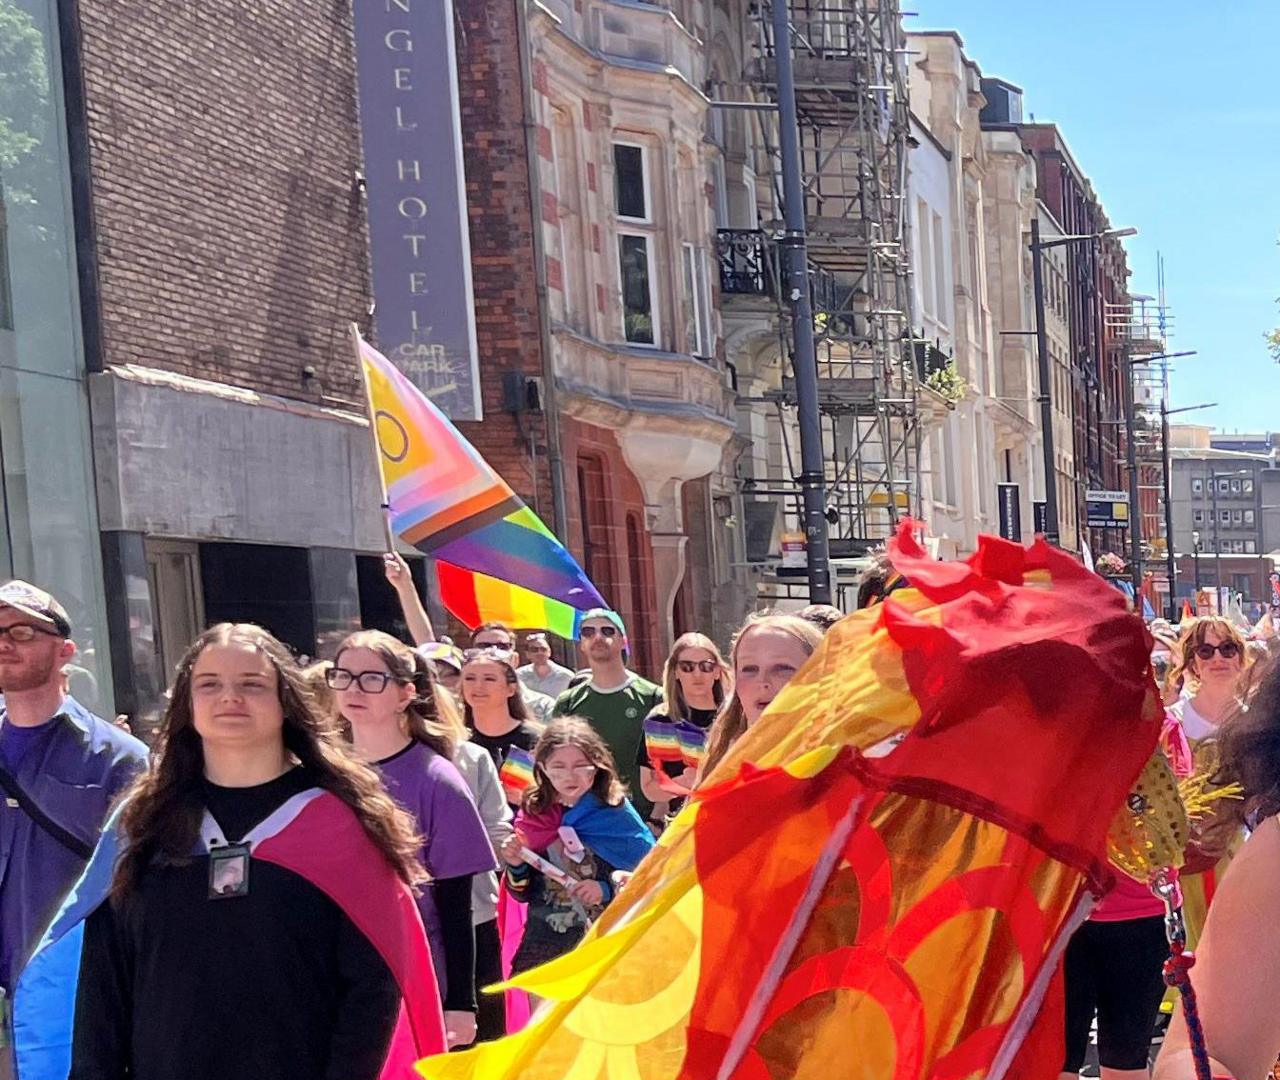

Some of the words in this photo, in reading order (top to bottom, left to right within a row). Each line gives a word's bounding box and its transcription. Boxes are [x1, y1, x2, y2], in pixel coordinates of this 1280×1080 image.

[385, 0, 418, 131] NGEL
[398, 160, 432, 335] HOTEL
[400, 343, 446, 358] CAR
